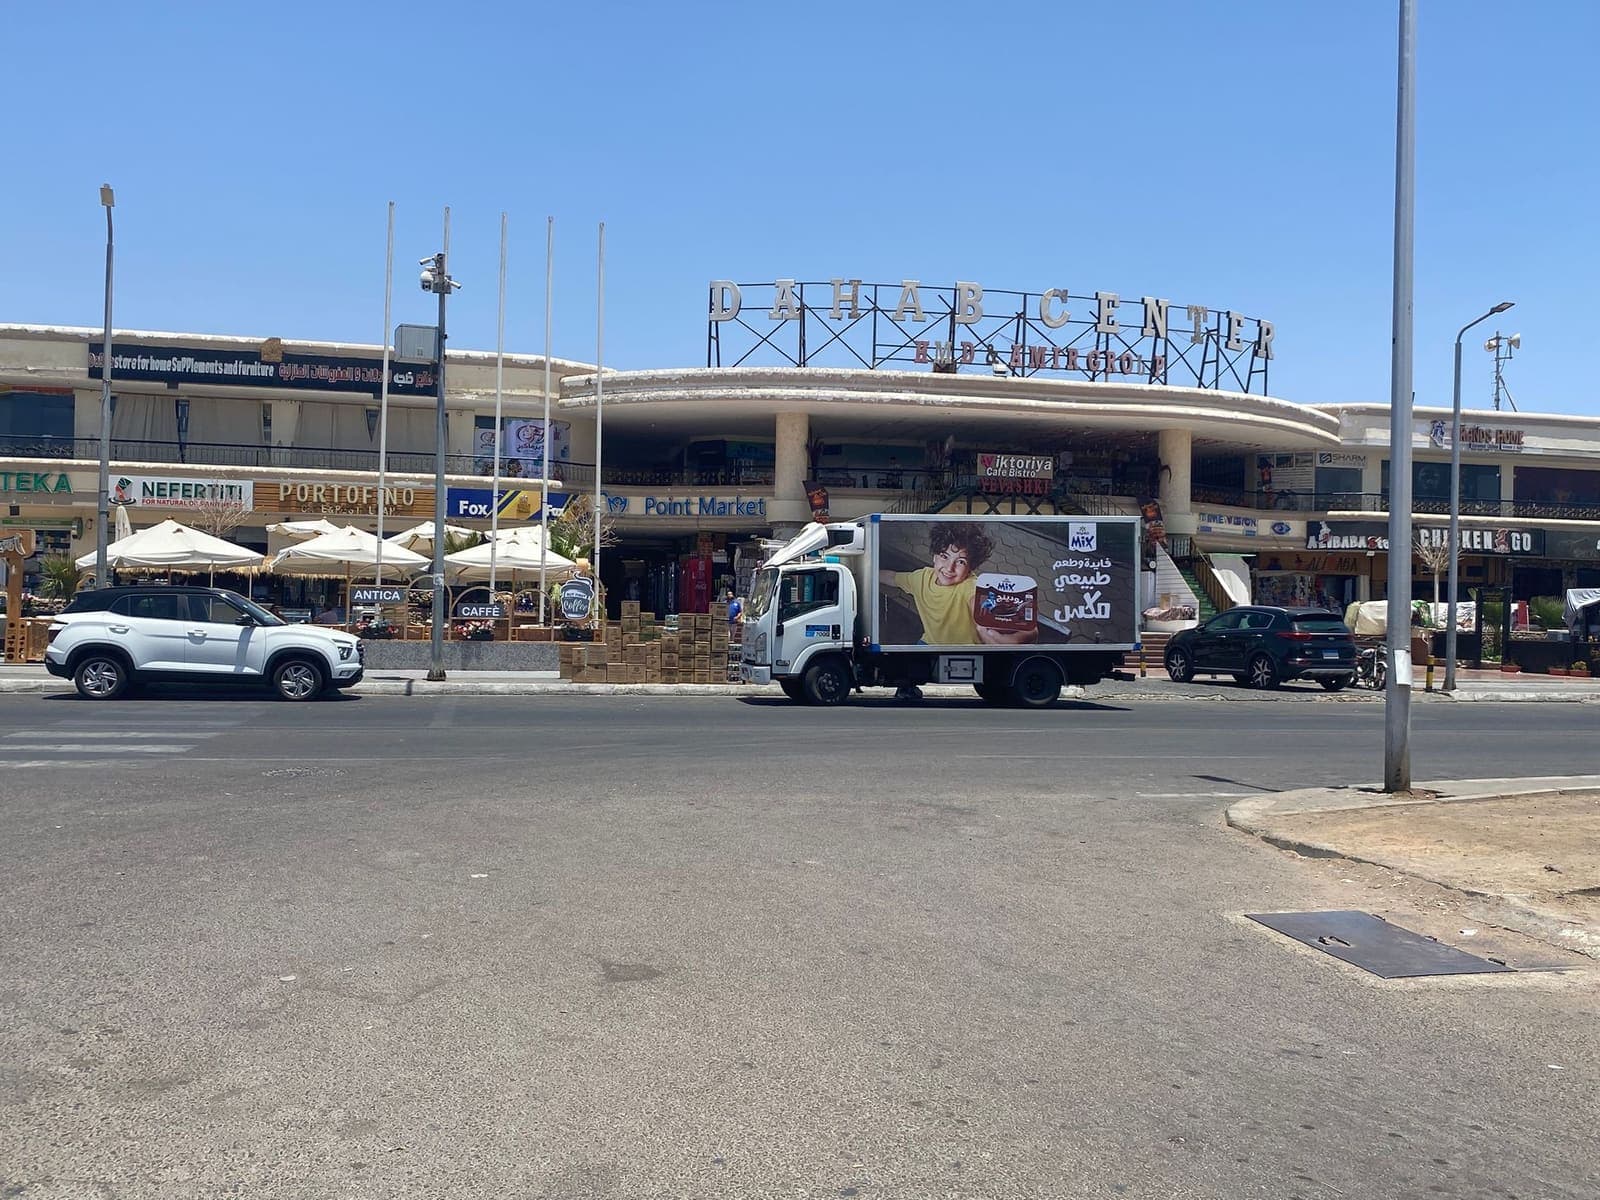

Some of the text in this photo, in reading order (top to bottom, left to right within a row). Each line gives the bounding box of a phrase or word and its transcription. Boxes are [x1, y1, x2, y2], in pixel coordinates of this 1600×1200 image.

[709, 278, 1276, 361] DAHAB CENTER
[114, 354, 137, 369] store
[138, 355, 149, 370] for
[150, 356, 171, 372] home
[224, 359, 238, 375] and
[238, 360, 274, 377] furniture
[1010, 344, 1077, 370] AMIR
[1332, 453, 1367, 462] SHARM
[1009, 468, 1036, 478] Bistro
[142, 482, 243, 500] NEFERTITI
[279, 483, 415, 506] PORTOFNO
[142, 499, 156, 507] FOR
[157, 500, 187, 508] NATURAL
[459, 500, 489, 515] Fox
[645, 497, 767, 516] Point Market
[1306, 535, 1367, 549] ALIBABA
[1419, 528, 1492, 549] CHIKEN
[1510, 532, 1531, 551] GO
[1054, 571, 1111, 592] طبيعي
[354, 590, 401, 601] ANTICA
[462, 605, 500, 617] CAFFÈ
